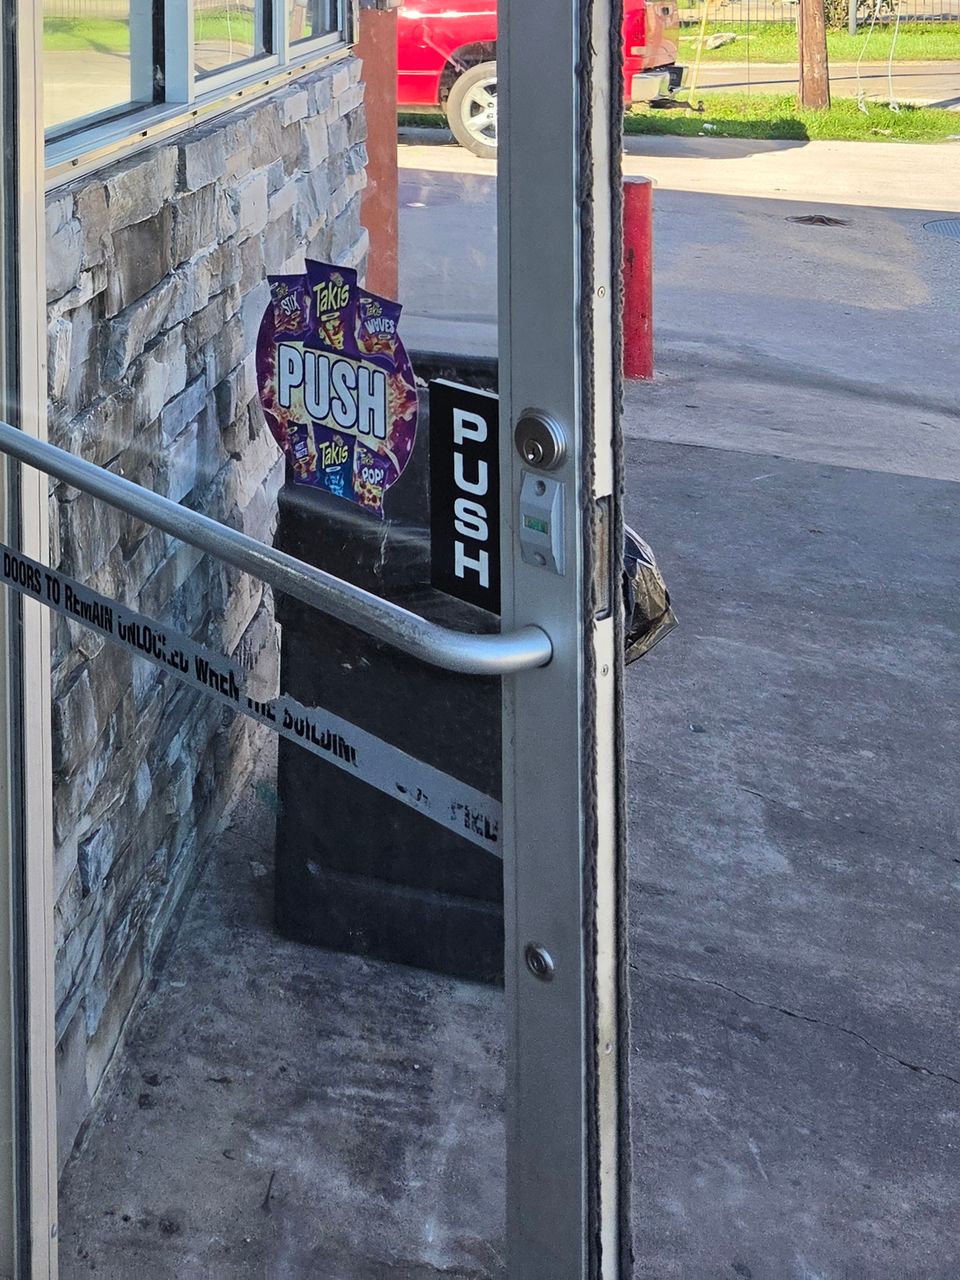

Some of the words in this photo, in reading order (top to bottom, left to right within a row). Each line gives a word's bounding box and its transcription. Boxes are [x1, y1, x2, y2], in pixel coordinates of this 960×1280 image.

[281, 292, 301, 316] STIX
[313, 281, 350, 318] Takis
[277, 342, 387, 440] PUSH
[319, 440, 349, 470] Takis
[362, 467, 384, 485] POP!
[452, 407, 490, 589] PUSH
[3, 551, 41, 595] DOORS
[44, 573, 61, 605] TO
[64, 583, 113, 634] REMAIN
